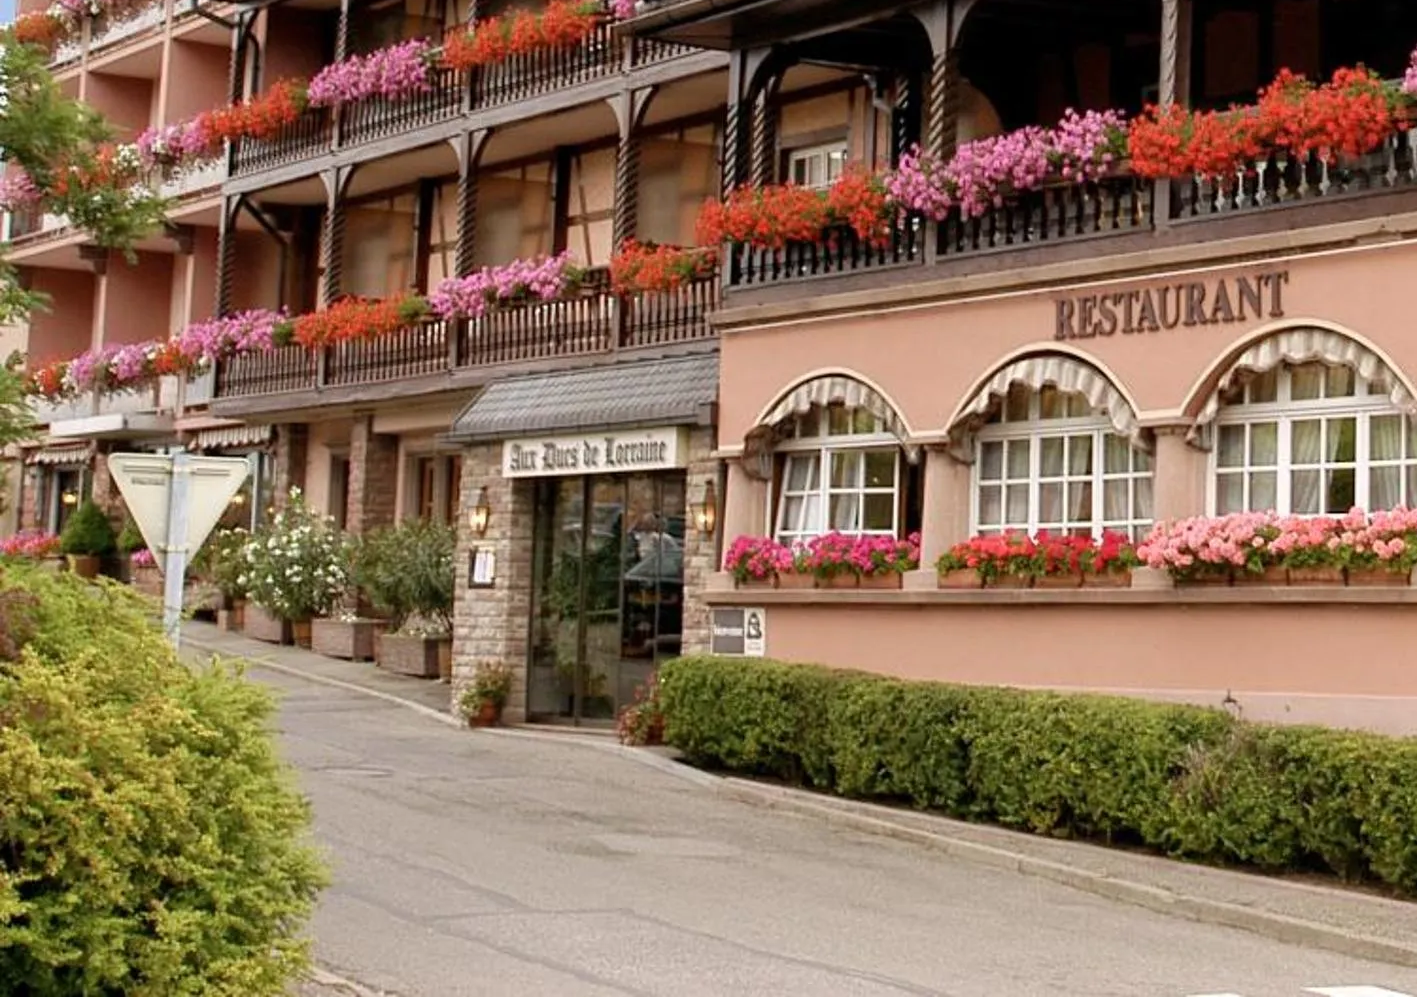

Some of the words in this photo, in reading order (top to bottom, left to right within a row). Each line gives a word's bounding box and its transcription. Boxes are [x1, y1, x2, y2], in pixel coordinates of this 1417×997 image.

[1054, 270, 1289, 341] RESTAURANT
[510, 443, 537, 472] Aux
[583, 439, 600, 468] de
[604, 433, 667, 466] Lorraine
